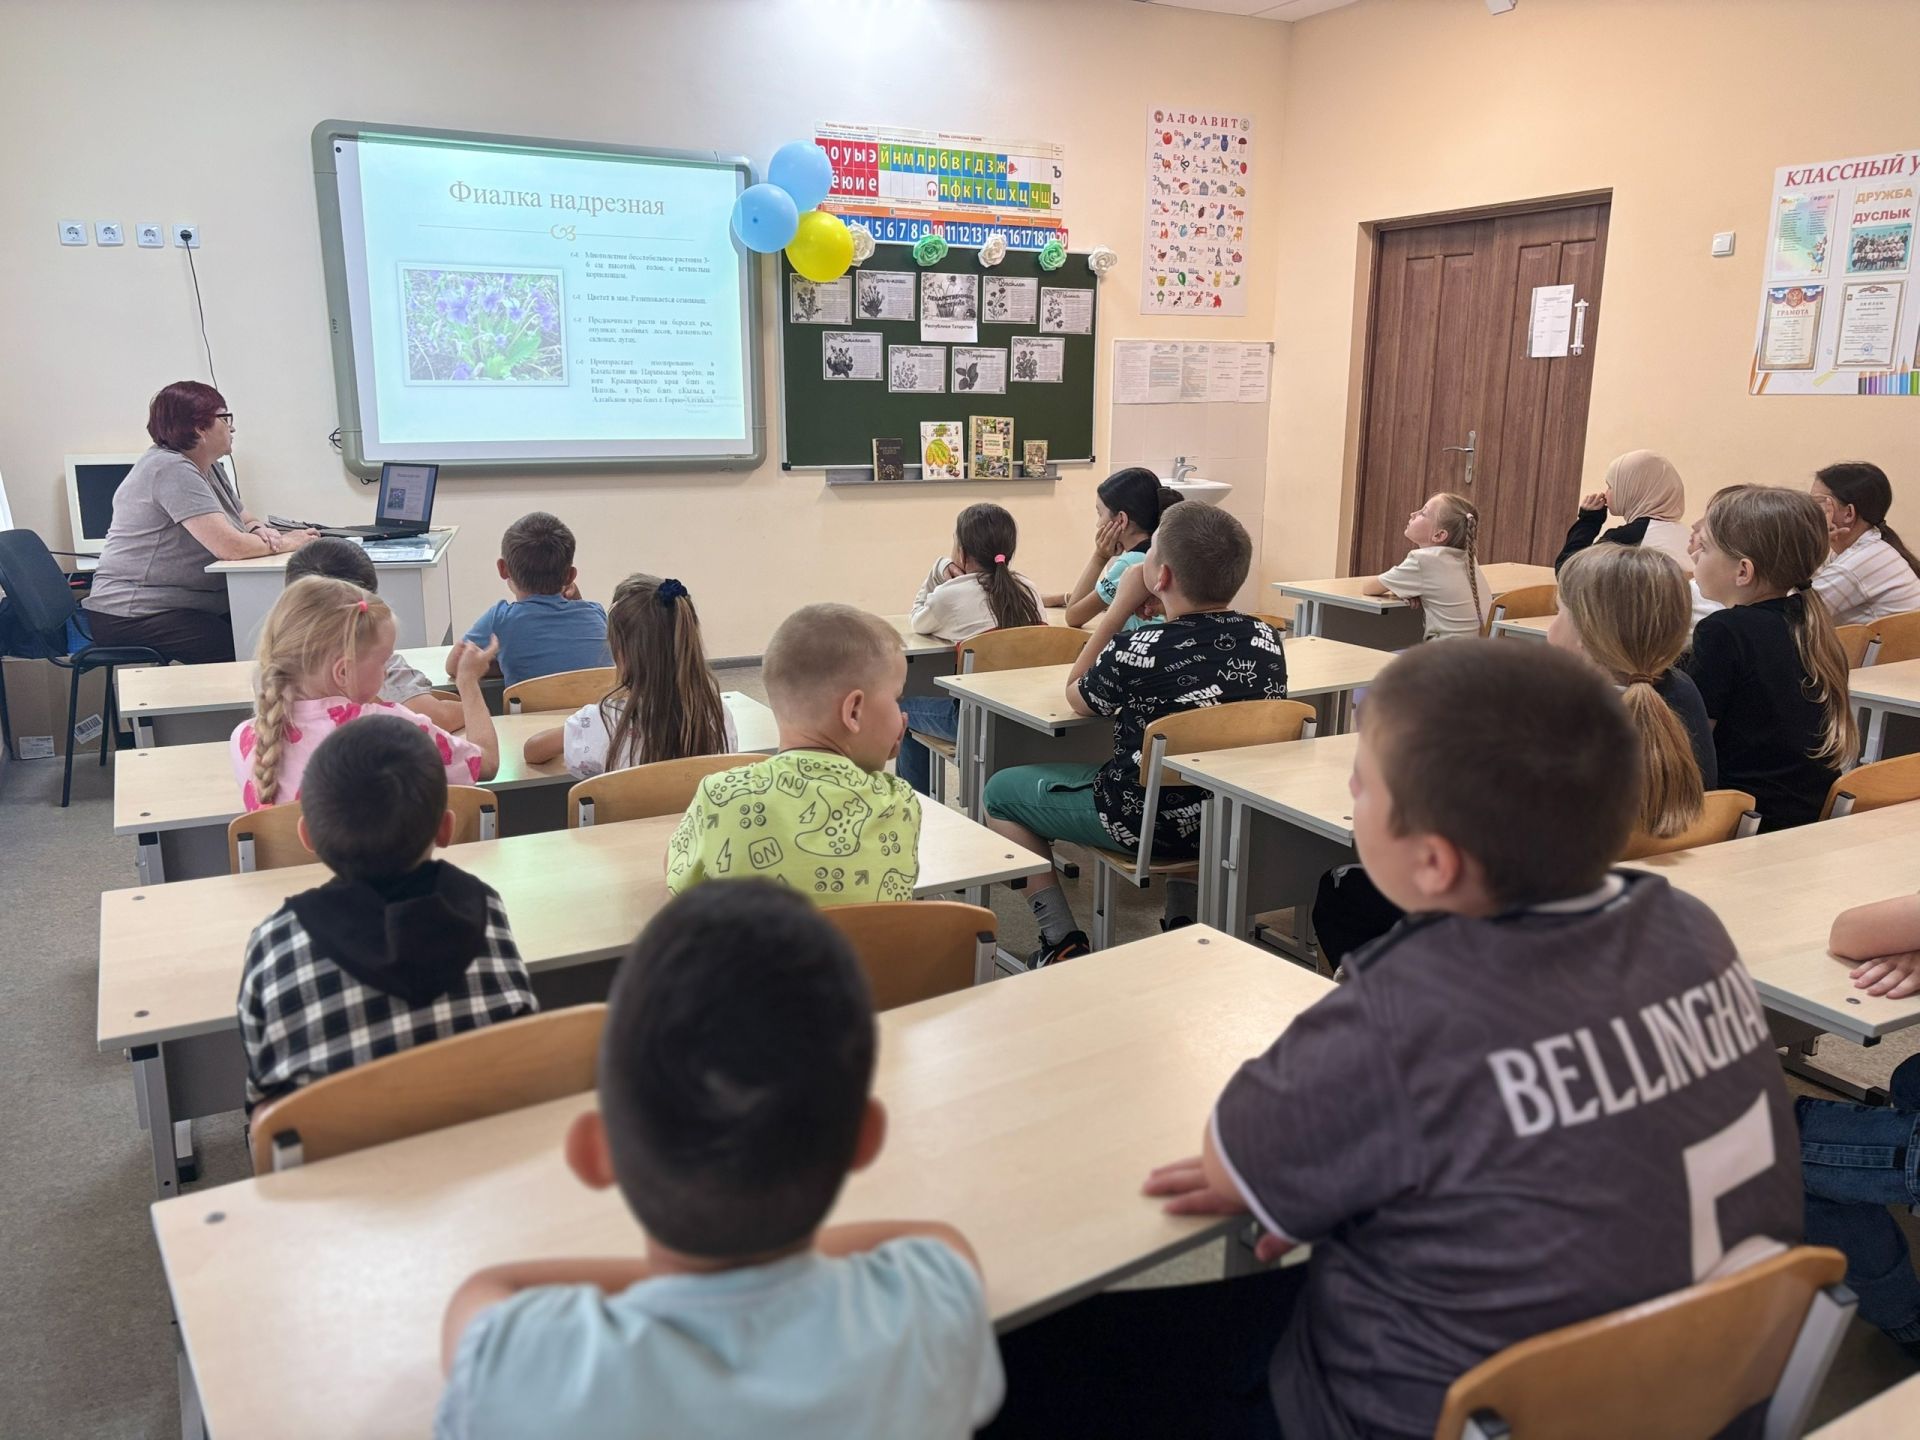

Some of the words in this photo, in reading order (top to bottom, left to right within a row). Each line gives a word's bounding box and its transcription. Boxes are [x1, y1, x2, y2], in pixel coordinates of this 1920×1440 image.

[1166, 112, 1239, 128] АЛФАВИТ
[1784, 154, 1906, 187] КЛАССНЫЙ
[449, 180, 542, 208] Фиалка
[550, 192, 665, 217] надрезная
[1856, 188, 1913, 204] ДРУЖБА
[1853, 208, 1912, 224] ДУСЛЫК
[1129, 630, 1164, 643] LIVE
[1259, 629, 1274, 643] THE
[1128, 641, 1151, 655] THE
[1250, 636, 1282, 656] DREAM
[1115, 651, 1156, 668] DREAM
[1164, 658, 1192, 672] DREAM
[1227, 658, 1256, 672] WHY
[1217, 669, 1257, 688] NOT?
[753, 842, 776, 865] ON
[1486, 960, 1770, 1138] BELLINGHA
